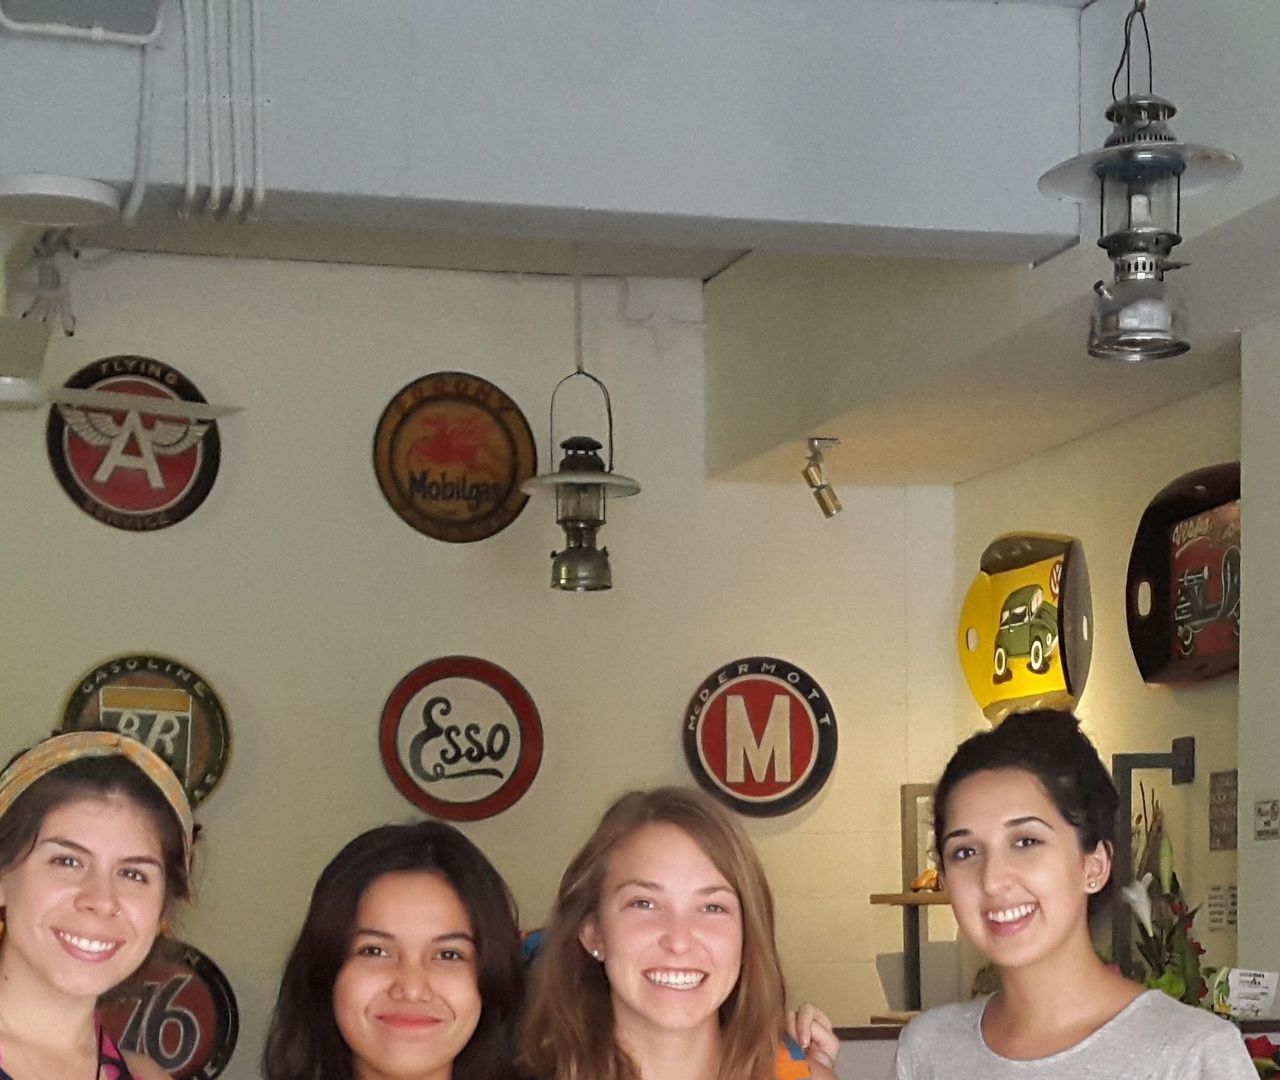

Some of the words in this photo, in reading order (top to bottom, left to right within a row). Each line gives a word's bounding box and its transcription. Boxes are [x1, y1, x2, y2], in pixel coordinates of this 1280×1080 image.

[100, 359, 178, 385] FLYING
[408, 696, 511, 783] Esso
[725, 693, 791, 783] M
